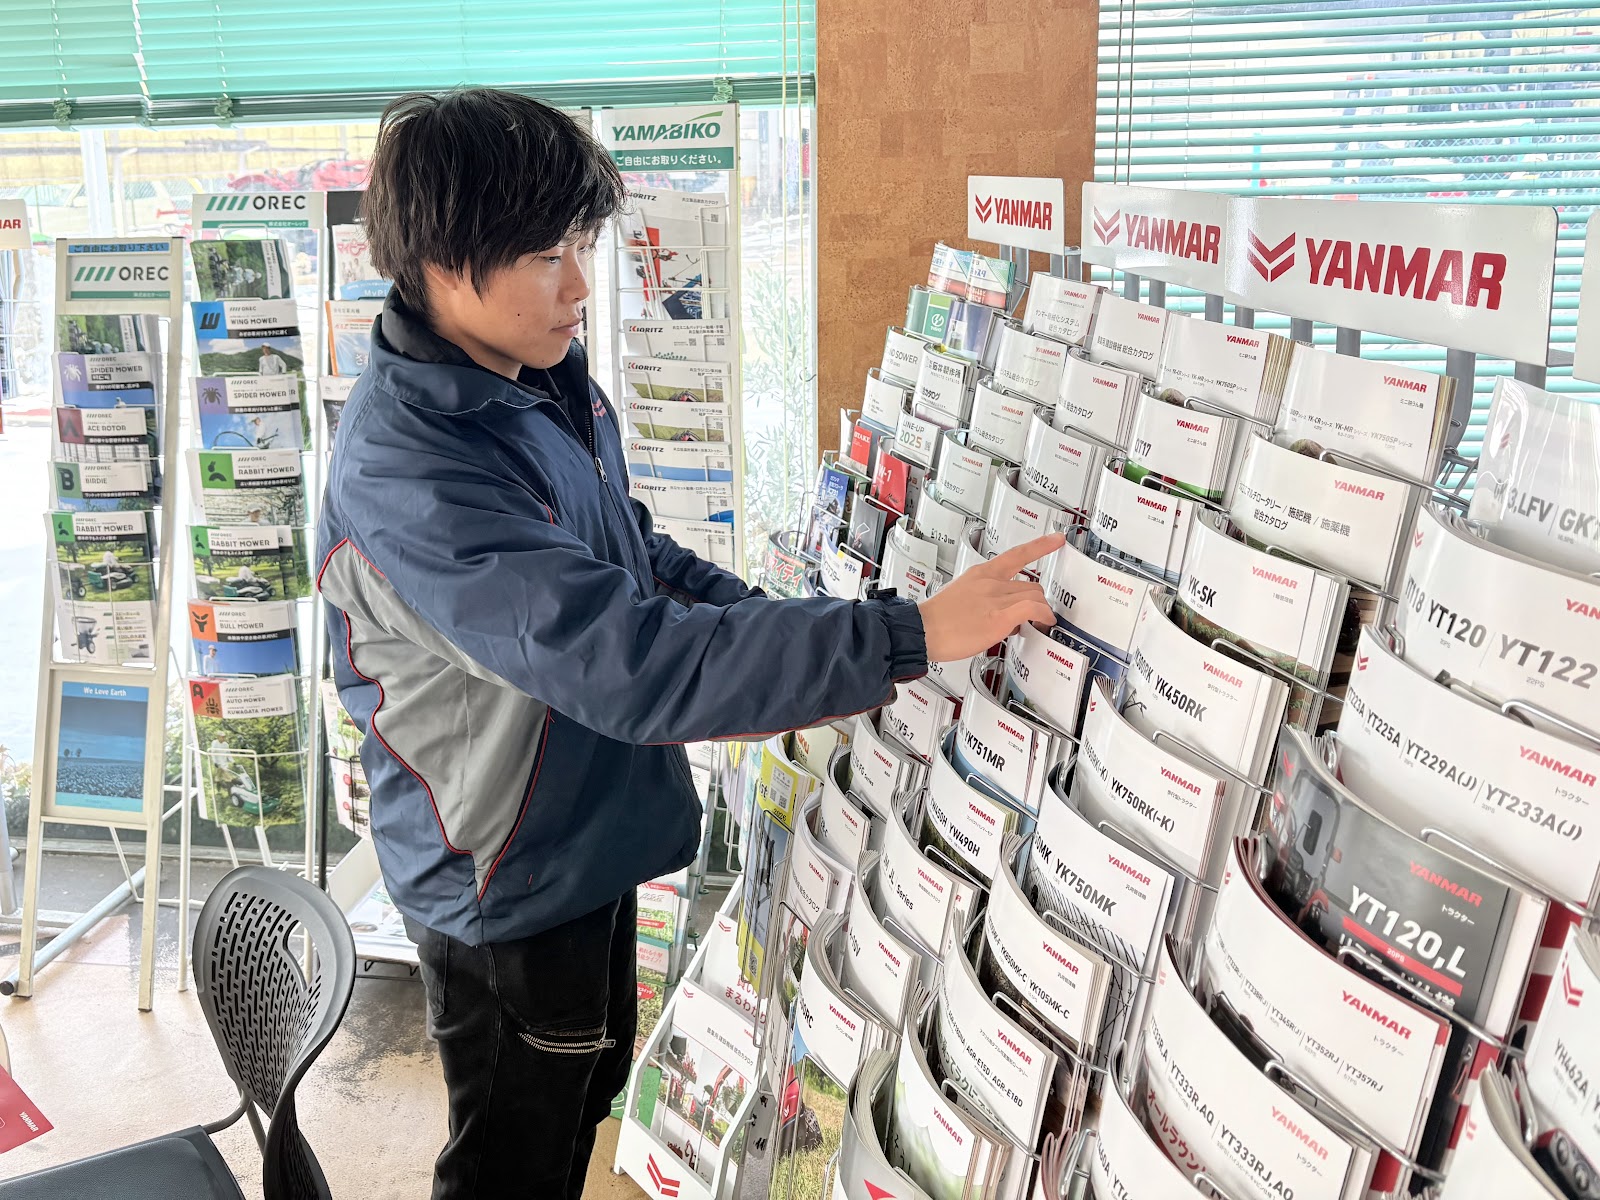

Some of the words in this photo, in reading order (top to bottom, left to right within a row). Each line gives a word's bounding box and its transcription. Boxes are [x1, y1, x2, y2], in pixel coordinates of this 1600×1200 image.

[611, 122, 721, 143] YAMABIKO
[615, 154, 722, 167] ご自由にお取りください。
[252, 194, 307, 210] OREC
[994, 197, 1053, 231] YANMAR
[74, 243, 165, 253] ご自由にお取り下さい
[1125, 213, 1221, 265] YANMAR
[118, 266, 170, 281] OREC
[1304, 237, 1508, 311] YANMAR
[1063, 289, 1087, 300] YANMAR
[250, 317, 278, 325] MOWER
[1137, 312, 1160, 324] YANMAR
[1035, 346, 1061, 358] YANMAR
[1226, 334, 1260, 349] YANMAR
[116, 365, 143, 373] MOWER
[894, 350, 918, 365] SOWER
[233, 391, 258, 399] SPIDER
[259, 390, 287, 398] MOWER
[1092, 377, 1118, 390] YANMAR
[1382, 375, 1427, 394] YANMAR
[1000, 405, 1024, 417] YANMAR
[1176, 418, 1210, 435] YANMAR
[899, 429, 923, 449] 2025
[1058, 442, 1082, 458] YANMAR
[267, 466, 295, 475] MOWER
[1333, 478, 1385, 501] YANMAR
[1016, 504, 1038, 520] YANMAR
[1136, 495, 1168, 513] YANMAR
[104, 524, 134, 532] MOWER
[1253, 508, 1289, 532] 総合カタログ
[1320, 517, 1352, 538] 施薬機
[211, 539, 237, 548] RABBIT
[239, 538, 270, 548] MOWER
[1097, 575, 1134, 596] YANMAR
[1251, 566, 1298, 590] YANMAR
[1188, 575, 1218, 609] YK-SK
[219, 622, 237, 630] BULL
[237, 622, 264, 630] MOWER
[1426, 598, 1487, 649] YT120
[1498, 632, 1600, 690] YT122
[1046, 648, 1074, 671] YANMAR
[1202, 660, 1244, 689] YANMAR
[83, 686, 95, 695] We
[95, 686, 110, 696] Love
[110, 687, 127, 697] Earth
[907, 687, 929, 707] YANMAR
[1154, 674, 1209, 723] YK450RK
[260, 706, 284, 714] MOWER
[996, 719, 1025, 743] YANMAR
[872, 747, 893, 770] YANMAR
[963, 726, 1007, 772] YK751MR
[1366, 708, 1404, 750] YT225A
[1403, 738, 1479, 793] YT229A(J)
[1485, 782, 1584, 842] YT233A(J)
[1519, 744, 1598, 788] YANMAR
[1160, 765, 1202, 796] YANMAR
[1111, 776, 1176, 834] YK750RK(-K)
[1553, 785, 1591, 808] トラクター
[968, 801, 997, 827] YANMAR
[948, 820, 982, 858] YW490H
[916, 866, 945, 895] YANMAR
[1107, 854, 1152, 887] YANMAR
[1054, 861, 1118, 918] YK750MK
[1409, 859, 1483, 909] YANMAR
[896, 884, 914, 911] Series
[1440, 904, 1476, 927] トラクター
[1349, 884, 1467, 979] YT120,L
[877, 939, 901, 969] YANMAR
[1042, 940, 1079, 976] YANMAR
[1028, 980, 1071, 1020] YK105MK-C
[828, 1002, 857, 1032] YANMAR
[1341, 989, 1413, 1041] YANMAR
[997, 1028, 1033, 1066] YANMAR
[1372, 1034, 1405, 1057] トラクター
[1344, 1062, 1384, 1093] YT357RJ
[1552, 1037, 1590, 1099] YH462A
[991, 1075, 1024, 1109] AGR-E18D
[932, 1106, 963, 1147] YANMAR
[1271, 1105, 1329, 1162] YANMAR
[1295, 1151, 1324, 1178] トラクター
